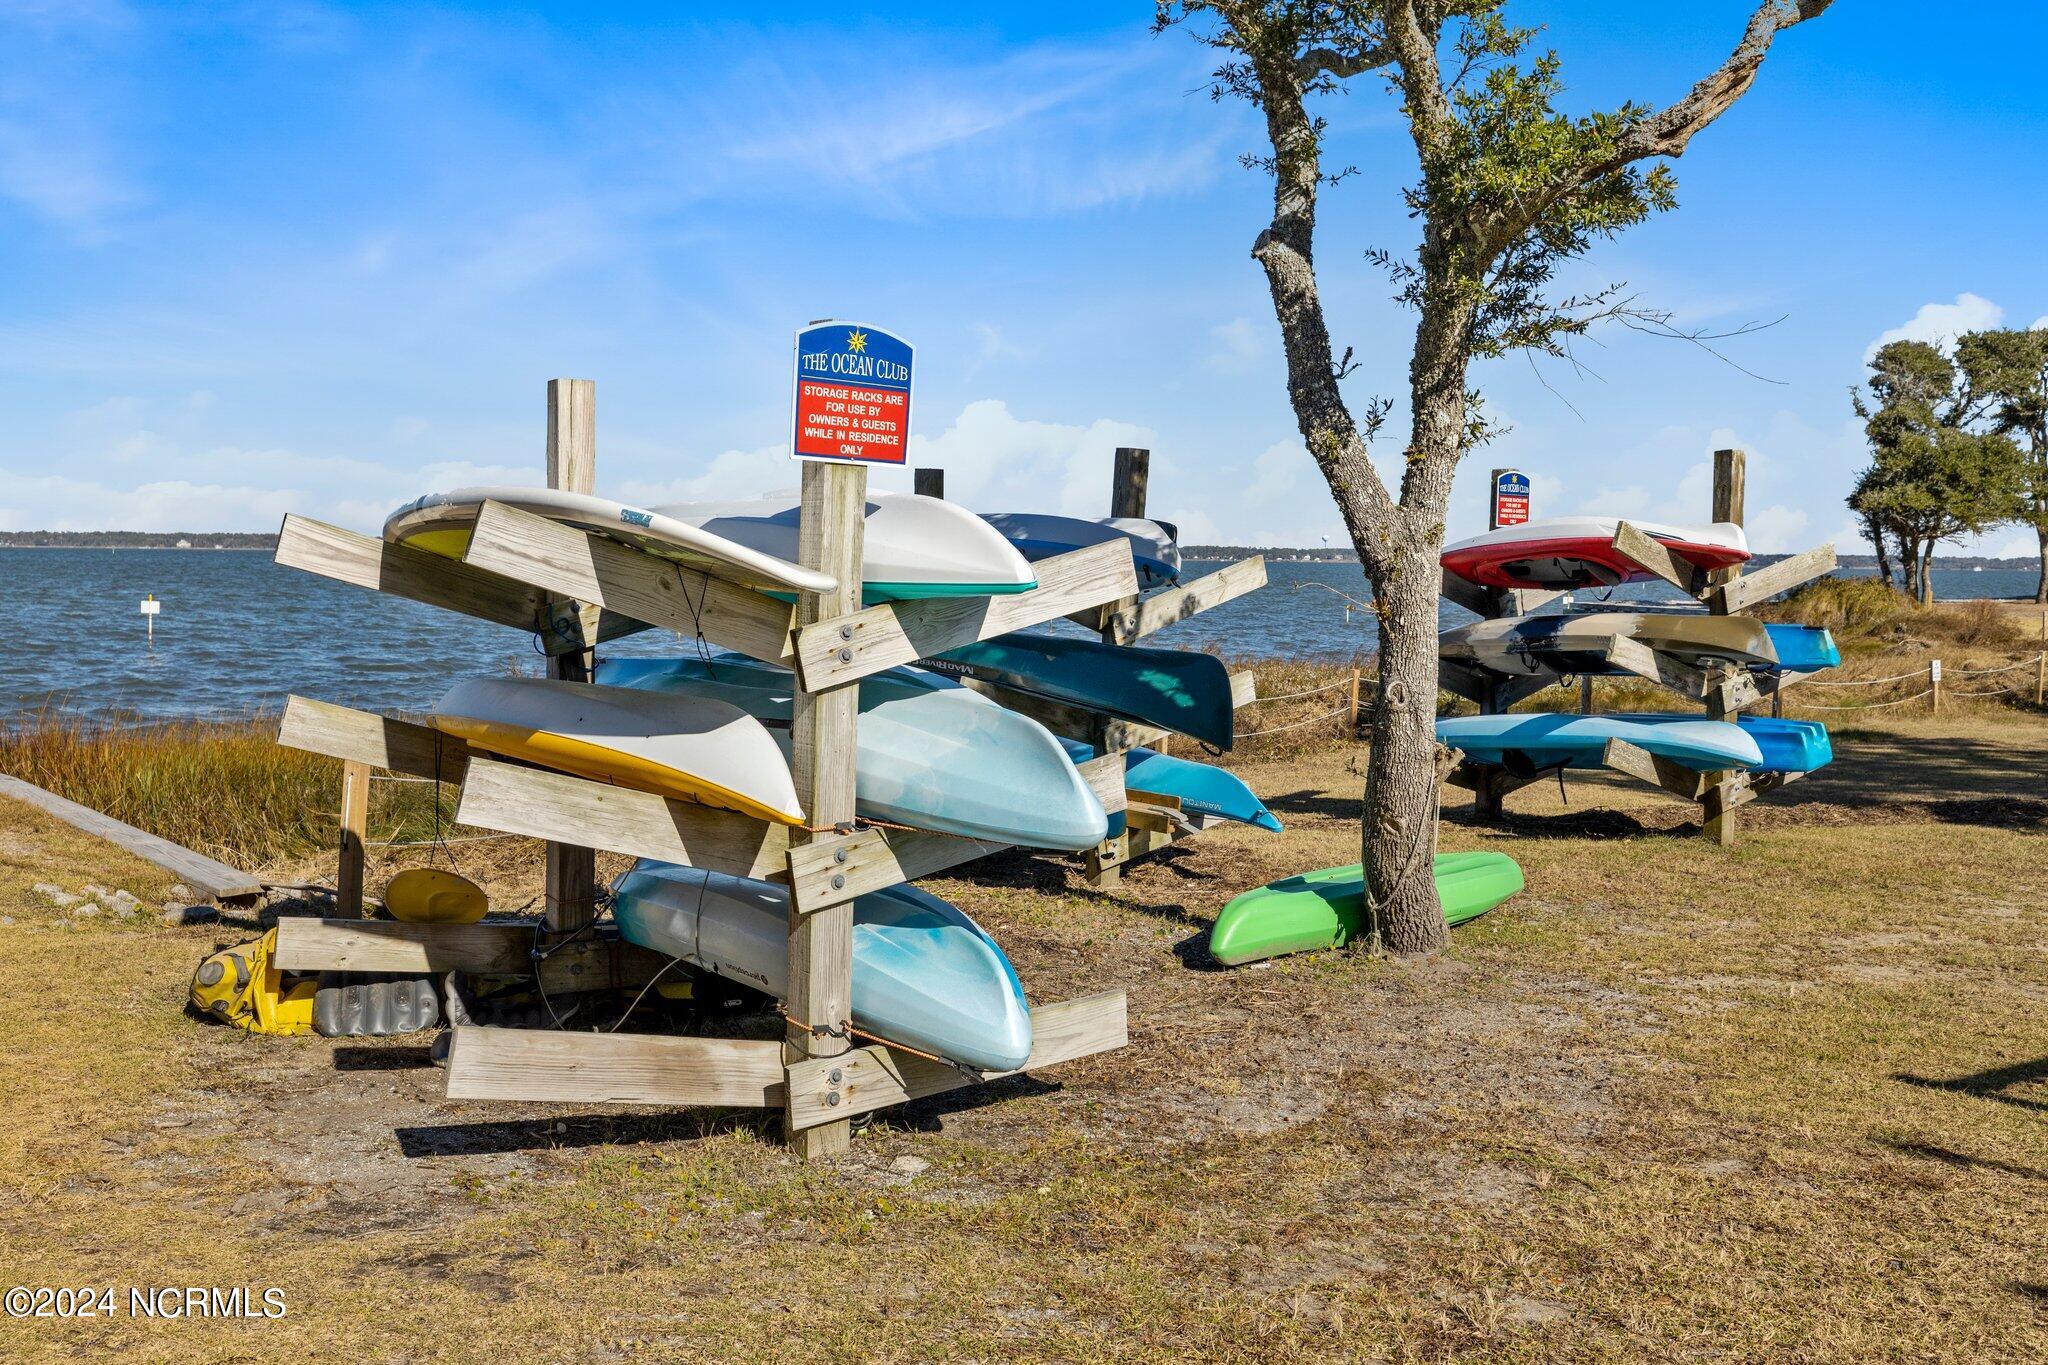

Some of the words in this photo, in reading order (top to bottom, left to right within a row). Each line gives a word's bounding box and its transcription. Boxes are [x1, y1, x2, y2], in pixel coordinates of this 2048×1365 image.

[802, 353, 828, 371] THE
[831, 353, 874, 377] OCEAN
[876, 359, 908, 381] CLUB
[804, 385, 849, 400] STORAGE
[851, 390, 883, 403] RACKS
[884, 395, 903, 406] ARE
[826, 402, 845, 413] FOR
[847, 404, 866, 415] USE
[868, 406, 881, 417] BY
[808, 413, 849, 427] OWNERS
[852, 418, 859, 428] &
[861, 419, 897, 431] GUESTS
[804, 427, 833, 439] WHILE
[836, 430, 846, 440] IN
[848, 432, 899, 446] RESIDENCE
[840, 444, 863, 455] ONLY
[1182, 798, 1222, 810] MANITOU
